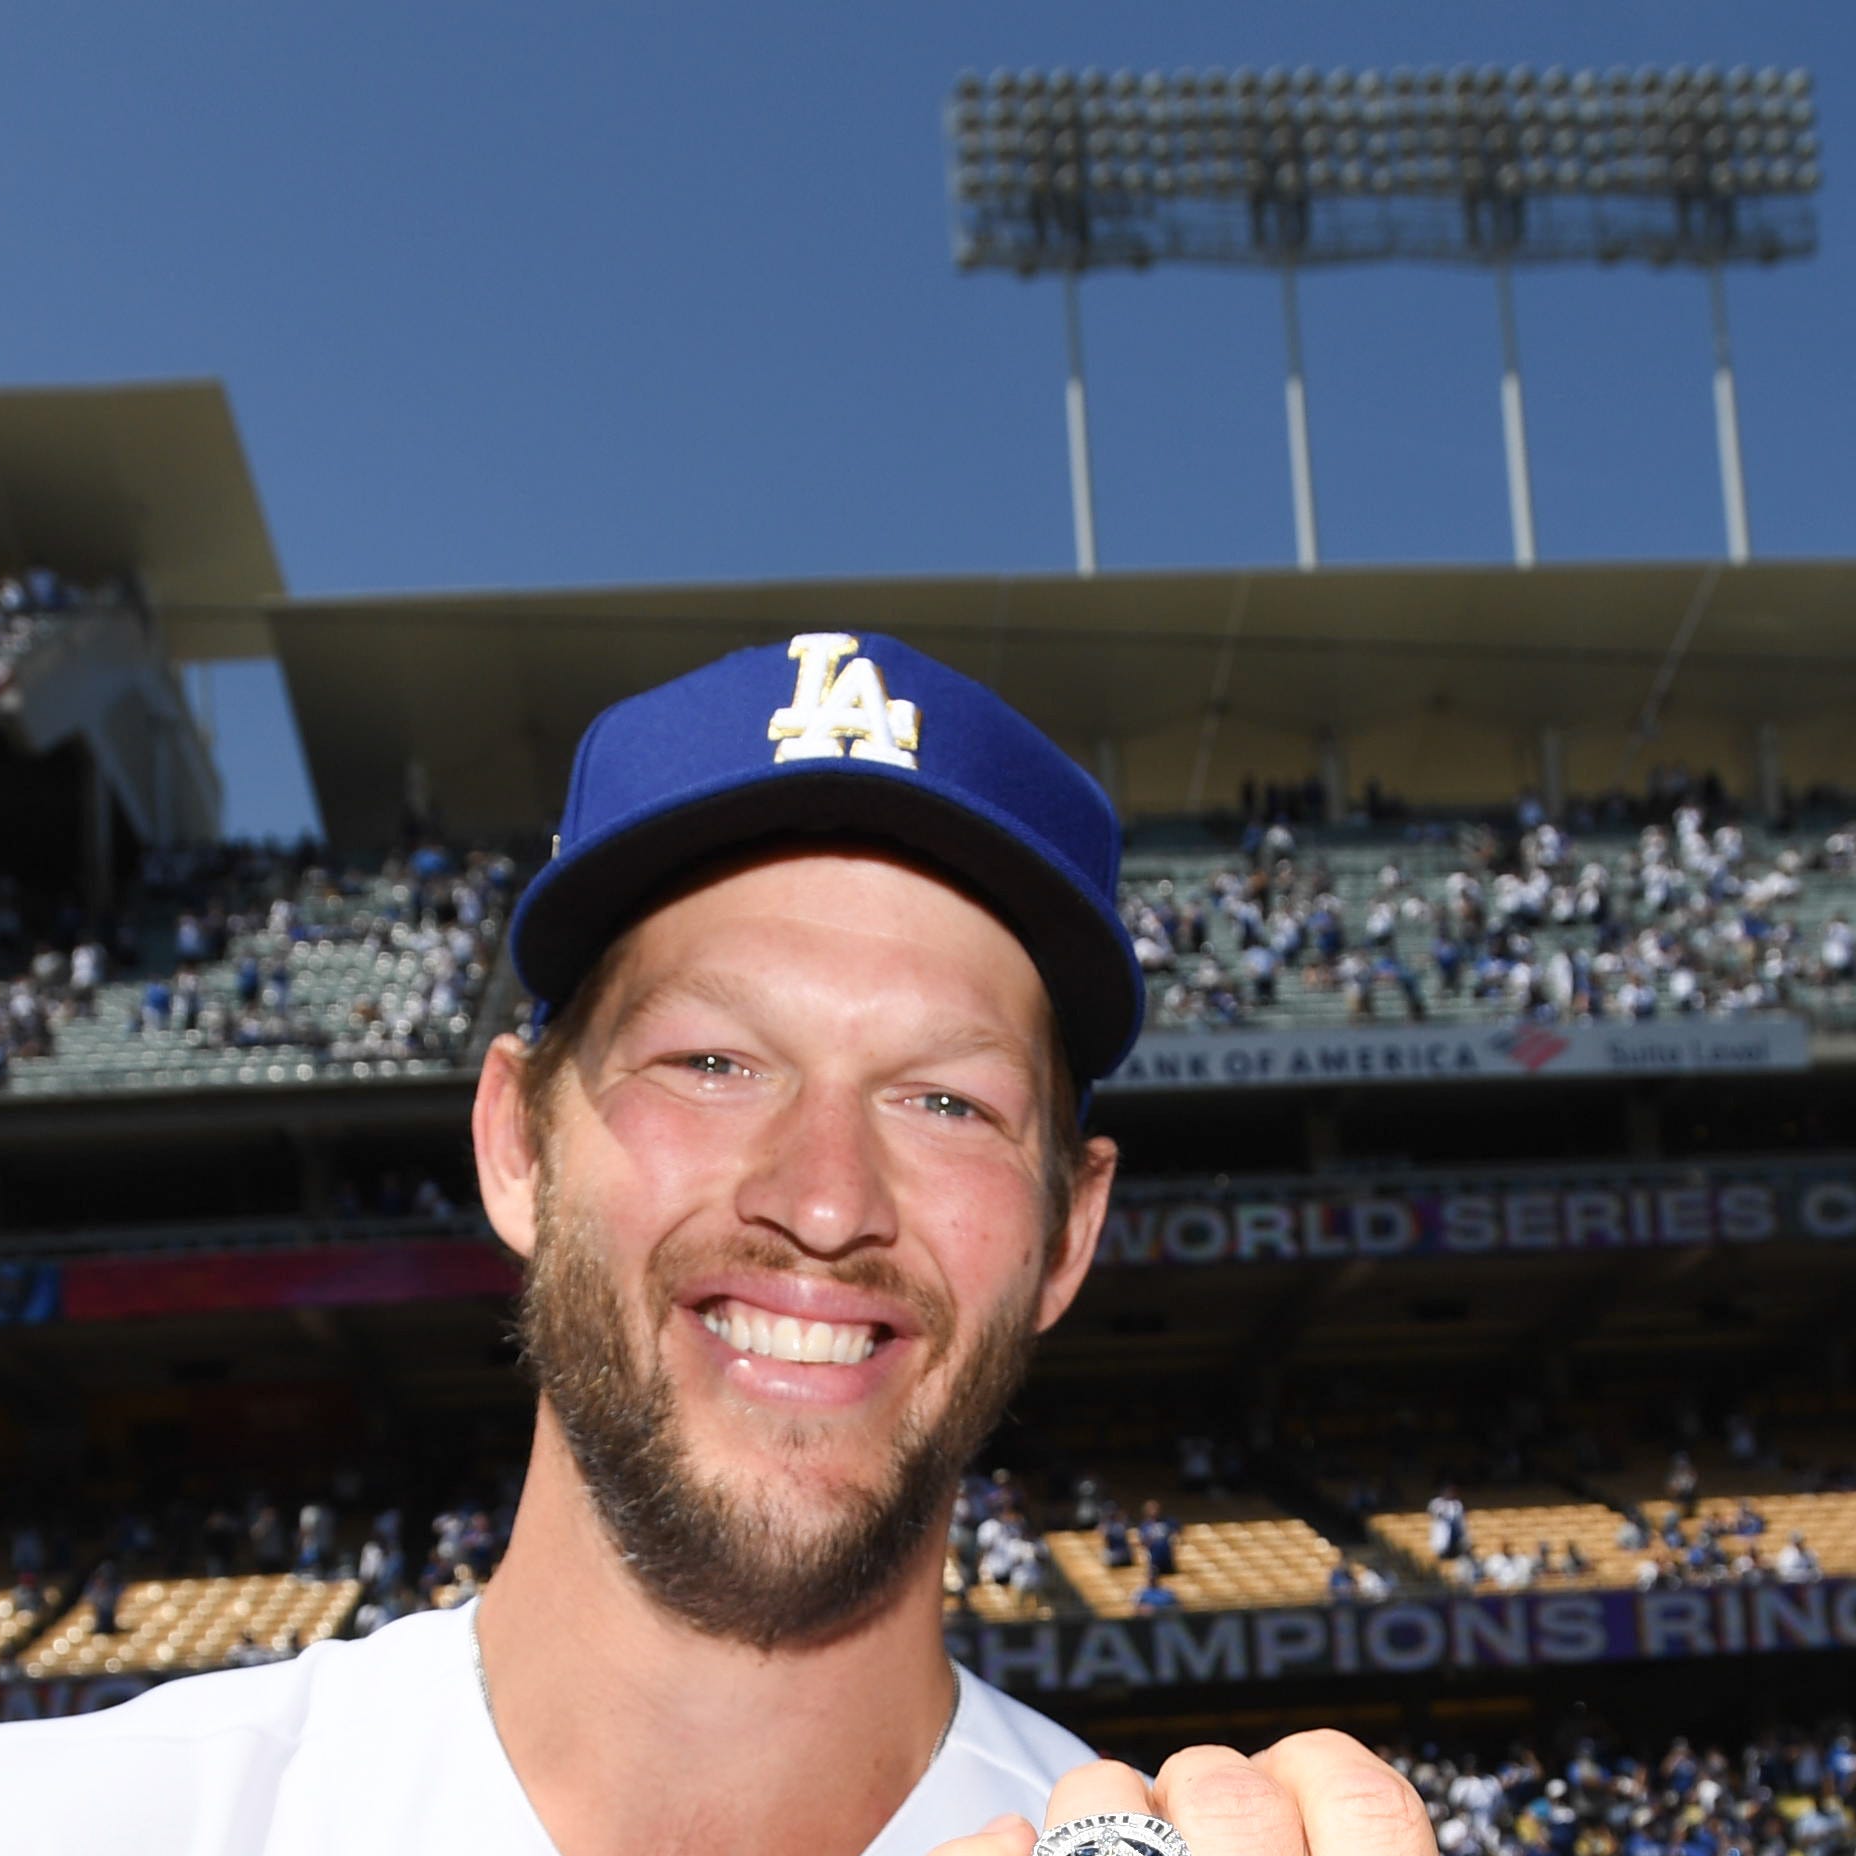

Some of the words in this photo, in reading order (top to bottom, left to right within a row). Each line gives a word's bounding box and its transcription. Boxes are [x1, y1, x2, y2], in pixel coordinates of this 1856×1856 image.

[768, 632, 921, 770] LA
[1120, 1045, 1214, 1083] ANK
[1223, 1044, 1274, 1079] OF
[1284, 1041, 1478, 1077] AMERICA
[1097, 1202, 1418, 1264] WORLD
[1442, 1184, 1777, 1252] SERIES
[946, 1590, 1607, 1694] HAMPIONS
